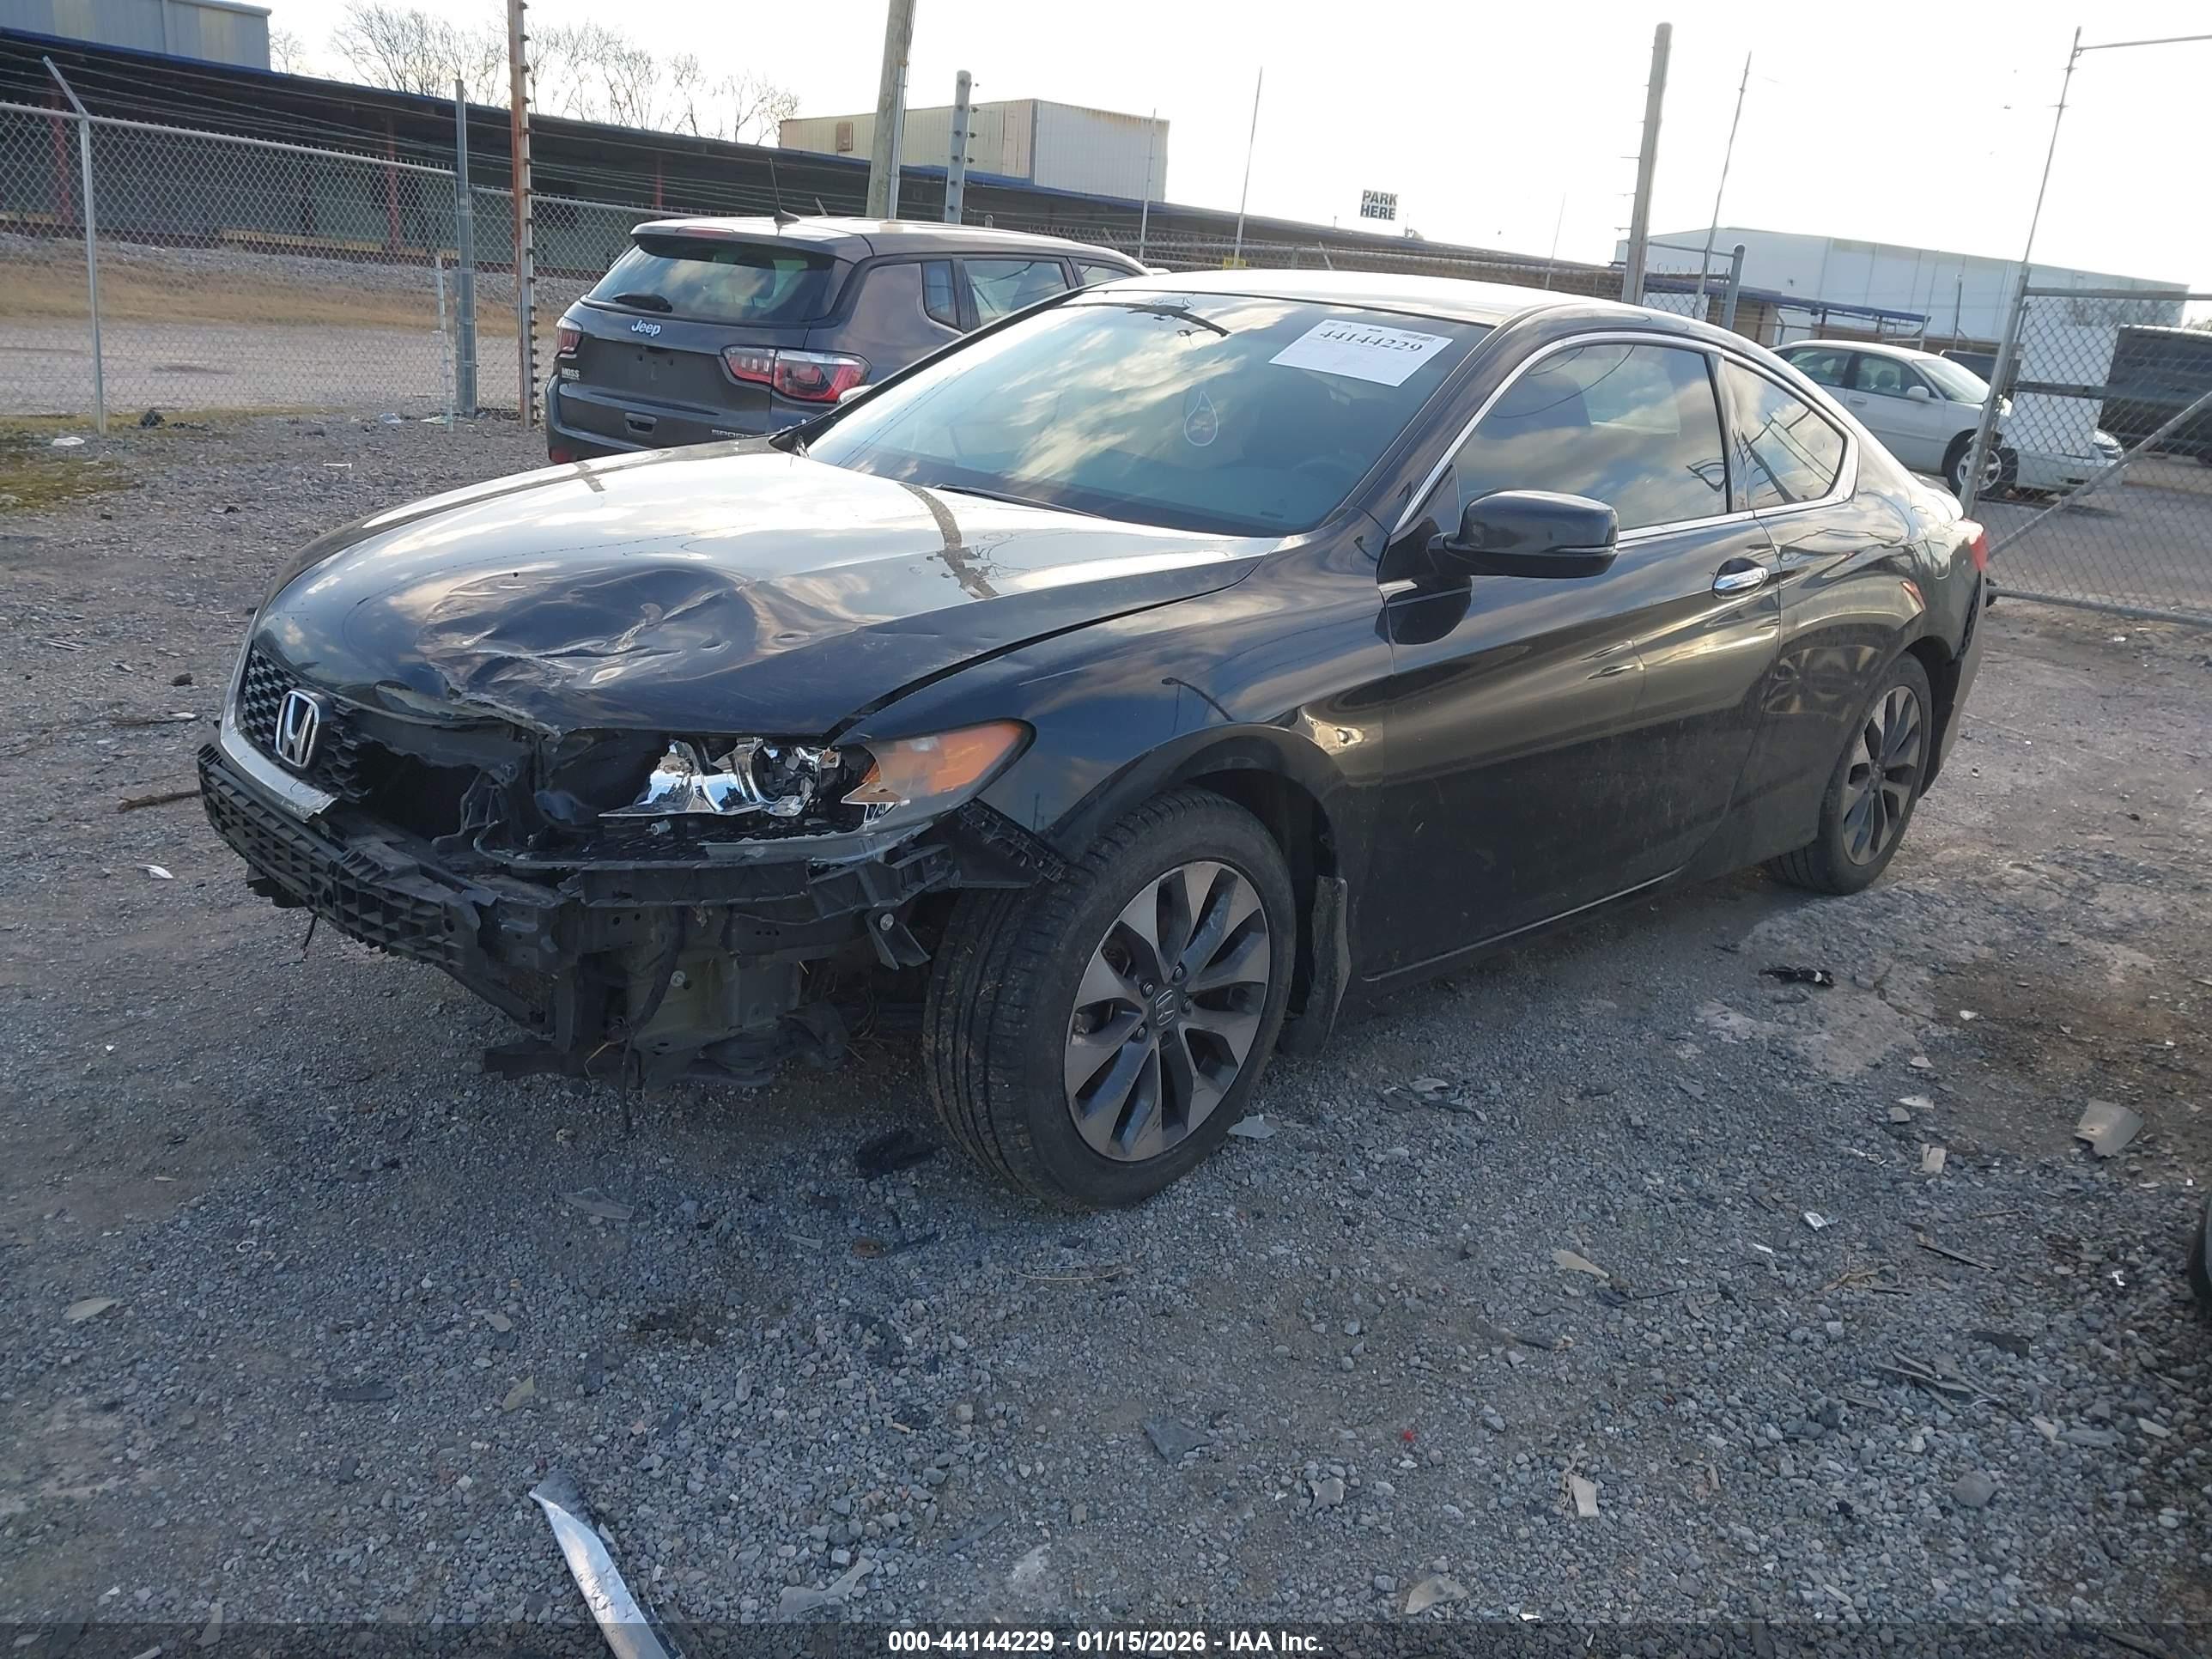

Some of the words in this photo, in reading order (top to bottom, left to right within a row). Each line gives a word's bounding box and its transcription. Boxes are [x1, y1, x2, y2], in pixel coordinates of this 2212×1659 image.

[1362, 189, 1398, 206] PARK
[1360, 204, 1396, 221] HERE
[631, 319, 661, 337] Jeep
[1320, 330, 1423, 353] 44144229
